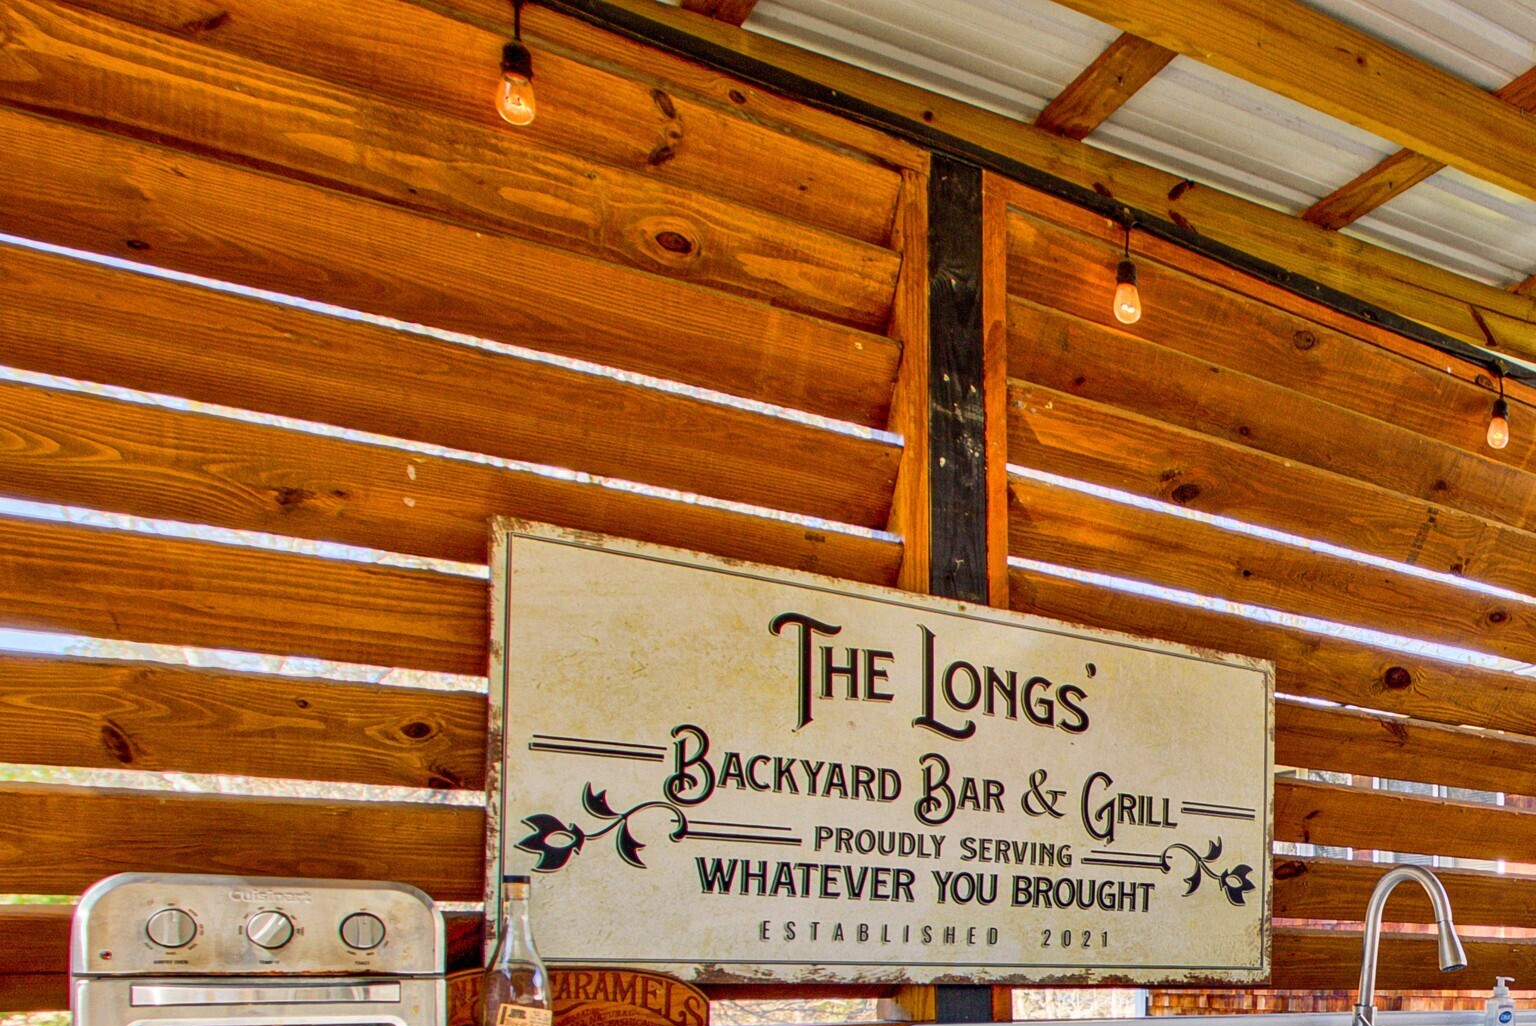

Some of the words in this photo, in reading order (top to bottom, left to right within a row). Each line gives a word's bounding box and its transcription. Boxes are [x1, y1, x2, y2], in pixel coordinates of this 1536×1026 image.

[768, 611, 895, 732] THE
[664, 724, 902, 806] BACKYARD
[913, 753, 1006, 826] BAR
[1020, 770, 1067, 818] &
[1081, 771, 1178, 844] GRILL
[813, 825, 945, 860] PROUDLY
[960, 836, 1073, 868] SERVING
[228, 889, 312, 904] Cuisinart
[695, 856, 915, 904] WHATEVER
[933, 870, 999, 908] YOU
[1011, 877, 1155, 914] BROUGHT
[759, 919, 1001, 948] ESTABLISHED
[1040, 928, 1111, 949] 2021
